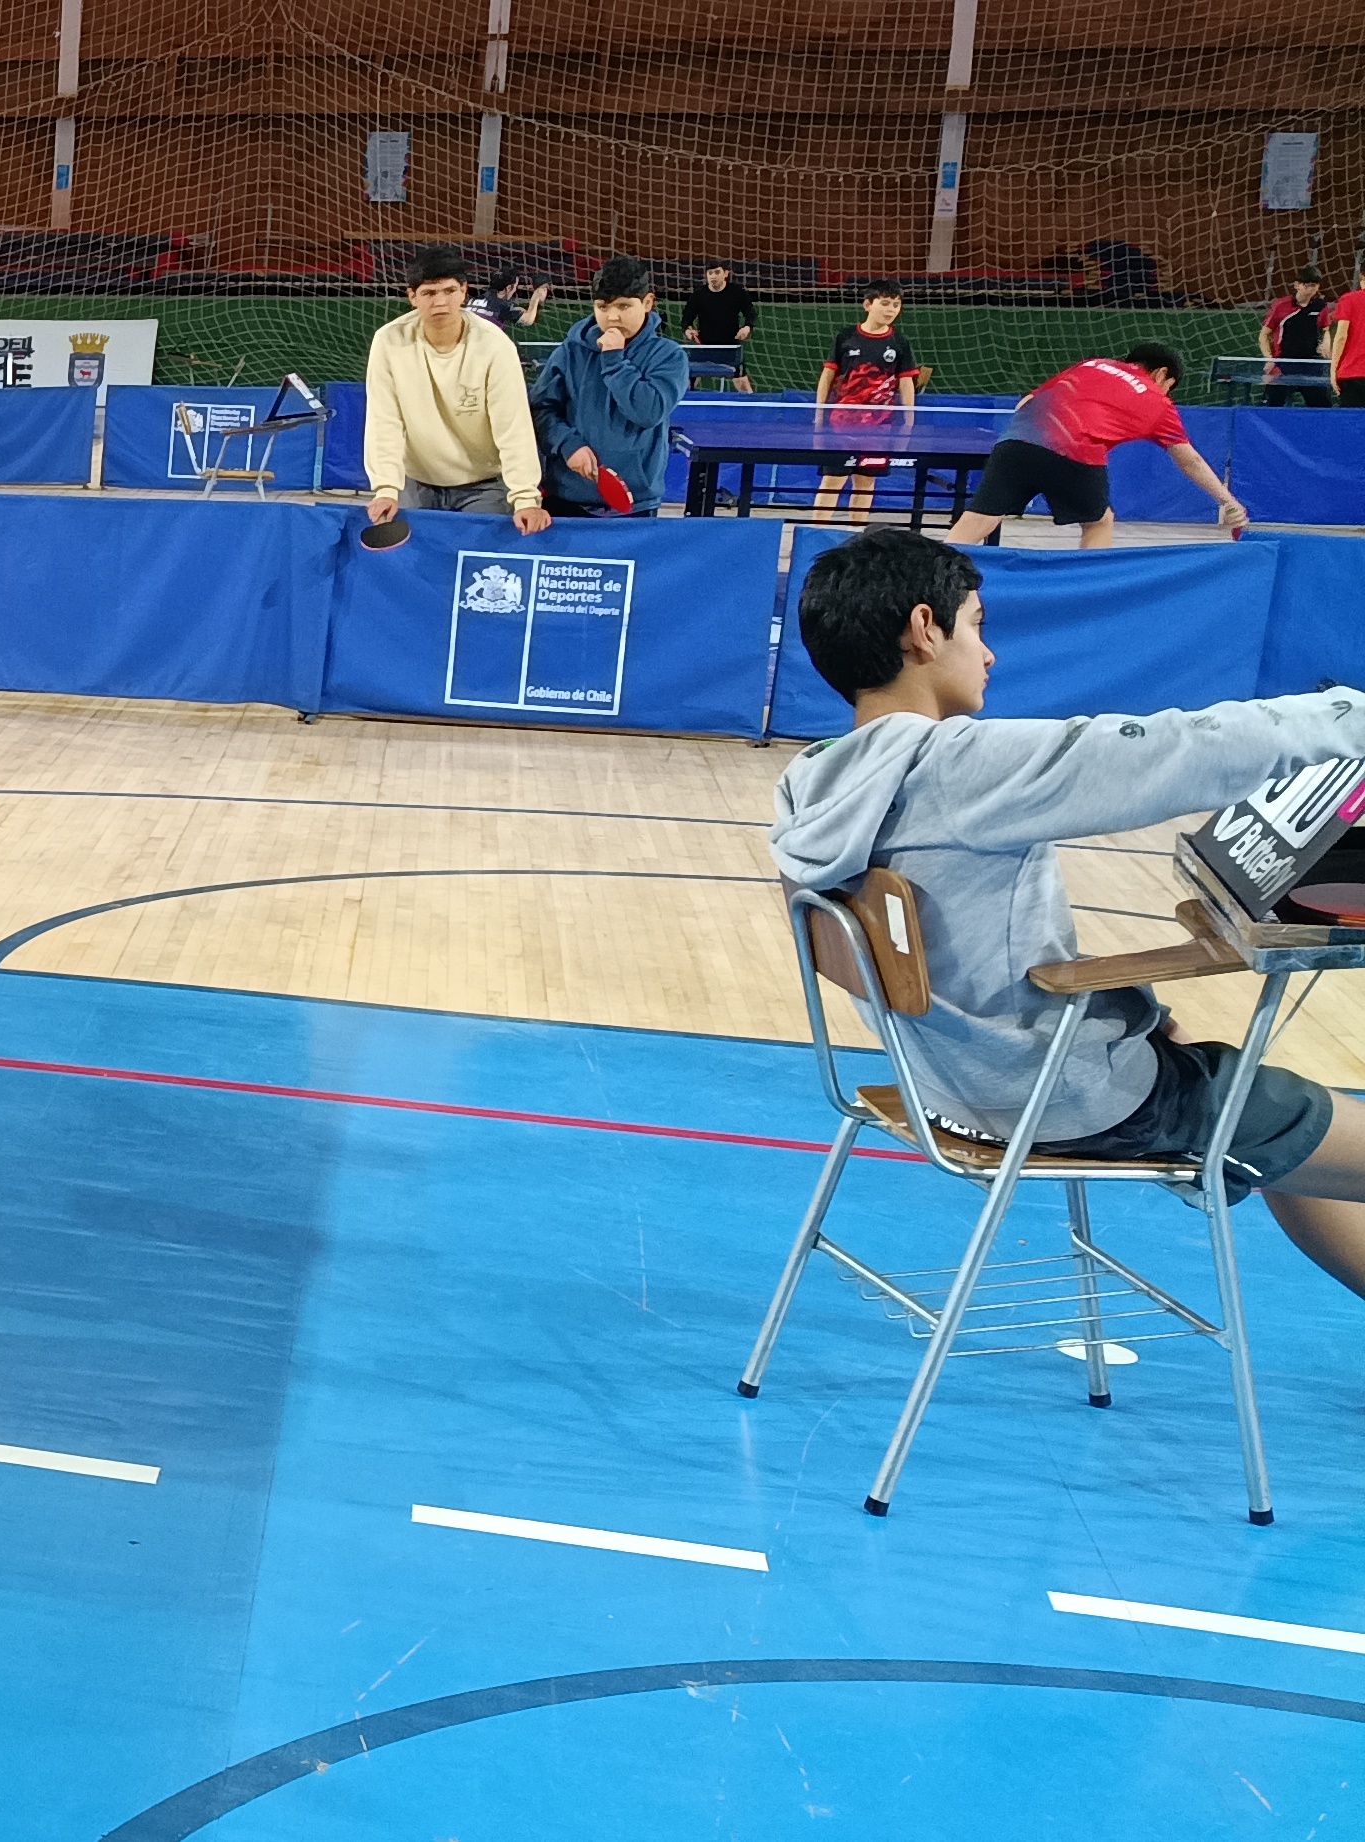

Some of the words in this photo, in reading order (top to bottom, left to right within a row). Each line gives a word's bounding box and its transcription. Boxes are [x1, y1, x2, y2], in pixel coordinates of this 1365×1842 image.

[540, 563, 603, 578] Instituto
[538, 576, 601, 591] Nacional
[603, 579, 622, 592] de
[538, 588, 603, 603] Deportes
[526, 685, 570, 700] Gobierno
[571, 688, 585, 701] de
[586, 689, 613, 703] Chile
[1228, 821, 1297, 901] Butterfly
